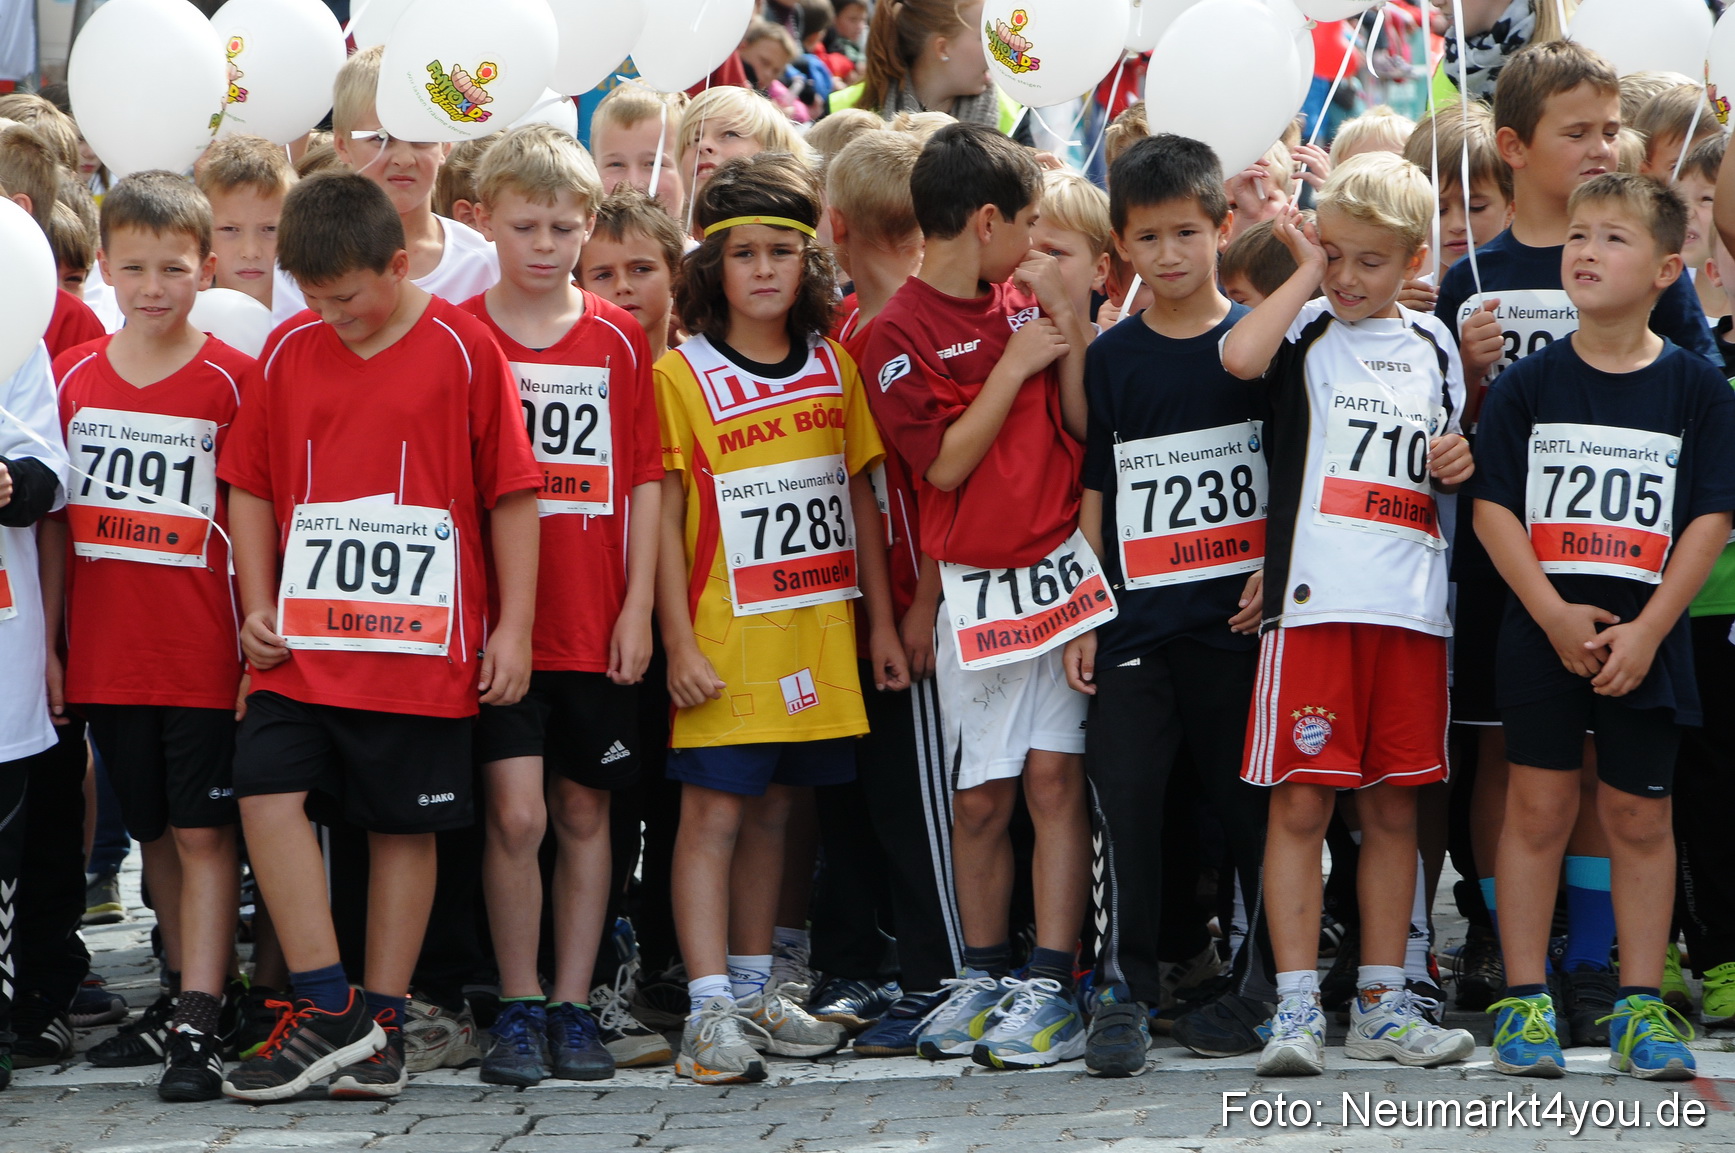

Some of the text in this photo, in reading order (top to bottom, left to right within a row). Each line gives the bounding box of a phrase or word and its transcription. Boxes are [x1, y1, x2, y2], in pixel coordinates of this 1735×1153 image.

[520, 378, 593, 396] Neumarkt
[1334, 395, 1390, 415] PARTL
[72, 421, 196, 448] PARTL Neumarkt
[717, 417, 788, 455] MAX
[1119, 441, 1243, 472] PARTL Neumarkt
[1533, 440, 1659, 463] PARTL Neumarkt
[80, 444, 196, 506] 7091
[721, 472, 835, 502] PARTL Neumarkt
[1131, 464, 1257, 533] 7238
[1543, 465, 1664, 527] 7205
[97, 515, 161, 544] Kilian
[295, 517, 428, 536] PARTL Neumarkt
[741, 495, 846, 560] 7283
[1170, 537, 1238, 565] Julian
[1561, 531, 1627, 558] Robin
[305, 539, 436, 596] 7097
[772, 560, 845, 592] Samuel
[962, 551, 1084, 620] 7166
[327, 607, 405, 634] Lorenz
[600, 749, 631, 764] adidas
[430, 792, 455, 803] JAKO
